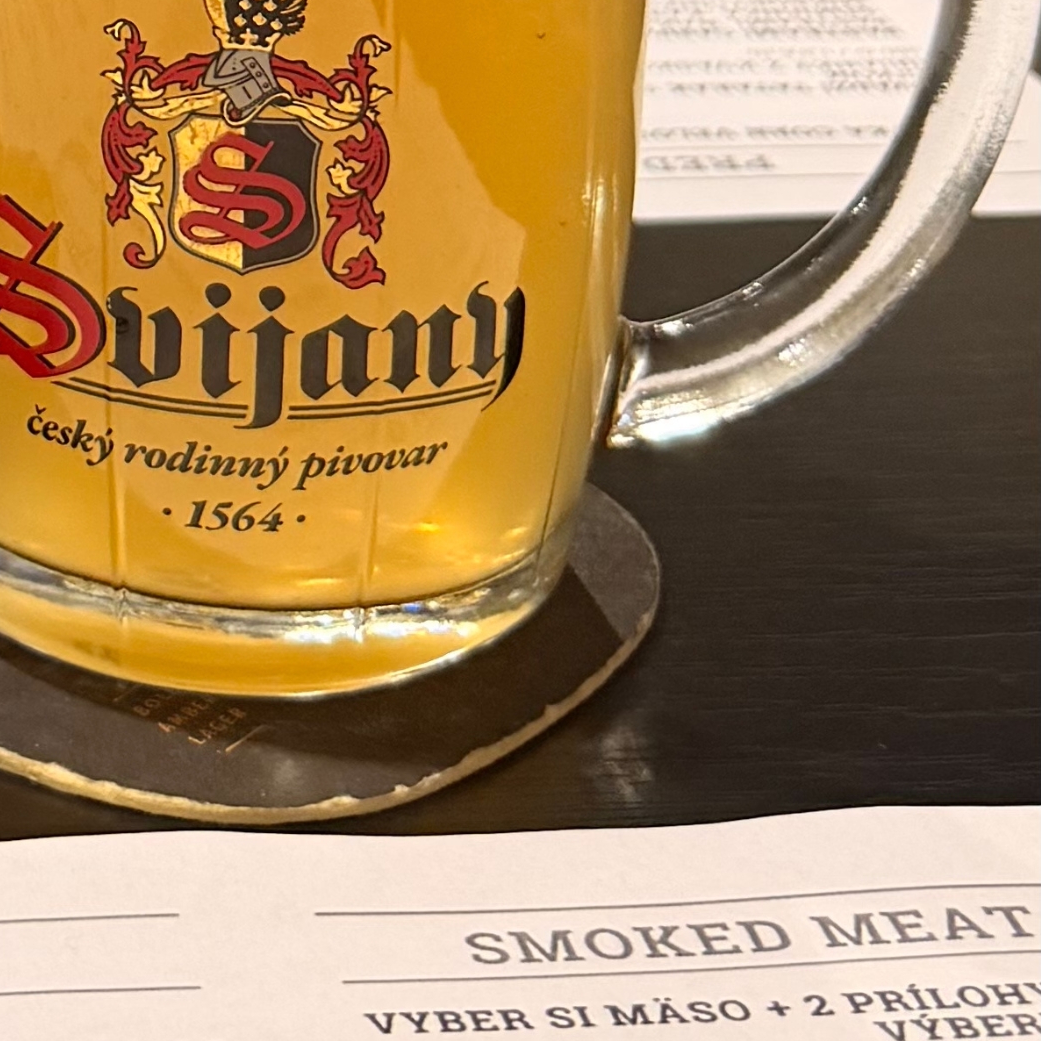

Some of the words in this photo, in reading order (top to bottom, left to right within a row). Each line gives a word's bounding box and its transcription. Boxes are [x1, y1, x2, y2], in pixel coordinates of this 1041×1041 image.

[178, 133, 306, 250] S
[26, 404, 114, 466] český
[124, 441, 289, 490] rodinný
[292, 440, 449, 491] pivovar
[184, 500, 284, 532] 1564
[188, 707, 246, 745] LAGER
[464, 919, 792, 965] SMOKED
[809, 905, 1034, 948] MEAT
[363, 1009, 535, 1035] VYBER
[545, 1005, 597, 1029] SI
[604, 996, 752, 1027] MÄSO
[767, 1001, 792, 1017] +
[802, 994, 836, 1016] 2
[873, 1013, 1041, 1041] VÝBER
